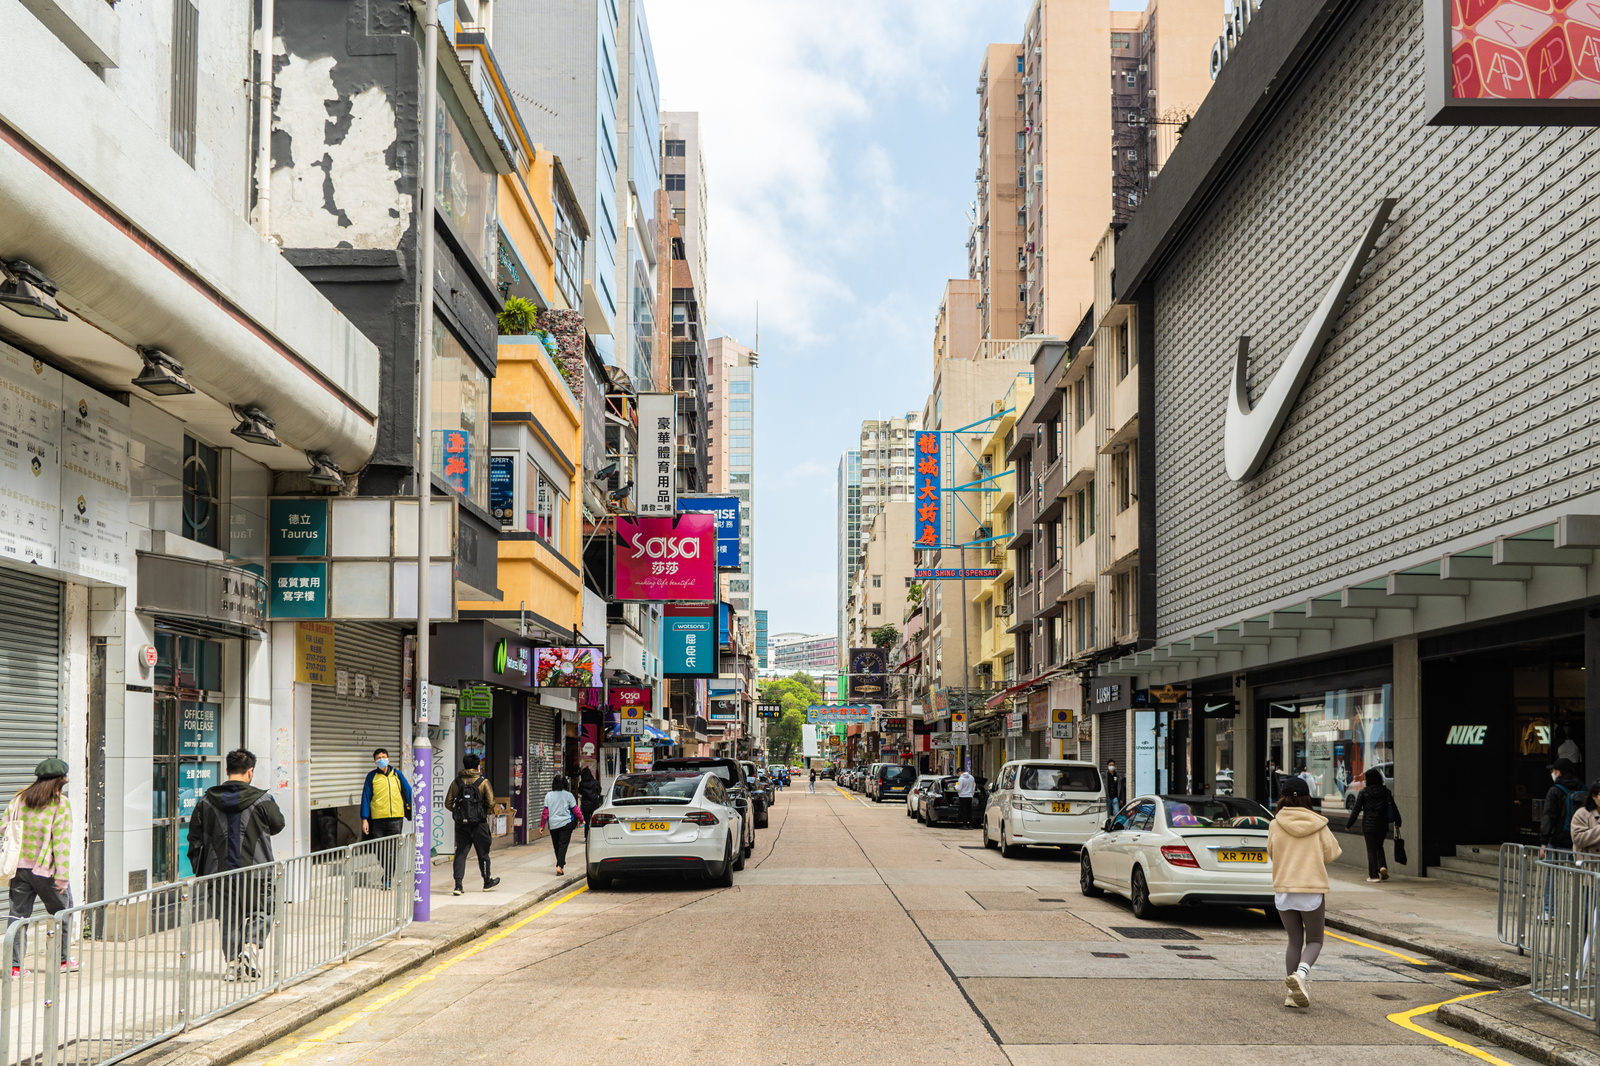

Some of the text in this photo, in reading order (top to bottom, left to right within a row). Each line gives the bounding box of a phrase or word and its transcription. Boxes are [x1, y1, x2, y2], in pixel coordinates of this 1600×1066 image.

[657, 417, 670, 503] 豪華體育用品
[280, 528, 318, 539] Taurus
[651, 561, 679, 575] 莎莎
[914, 569, 932, 577] LUNG
[935, 569, 956, 577] SHING
[685, 634, 697, 668] 屈臣氏
[1096, 685, 1111, 704] LUSH
[184, 709, 204, 720] OFFICE
[184, 720, 214, 731] FOR LEASE
[1445, 725, 1488, 745] NIKE
[649, 822, 666, 830] 666
[1222, 852, 1263, 862] XR 7178
